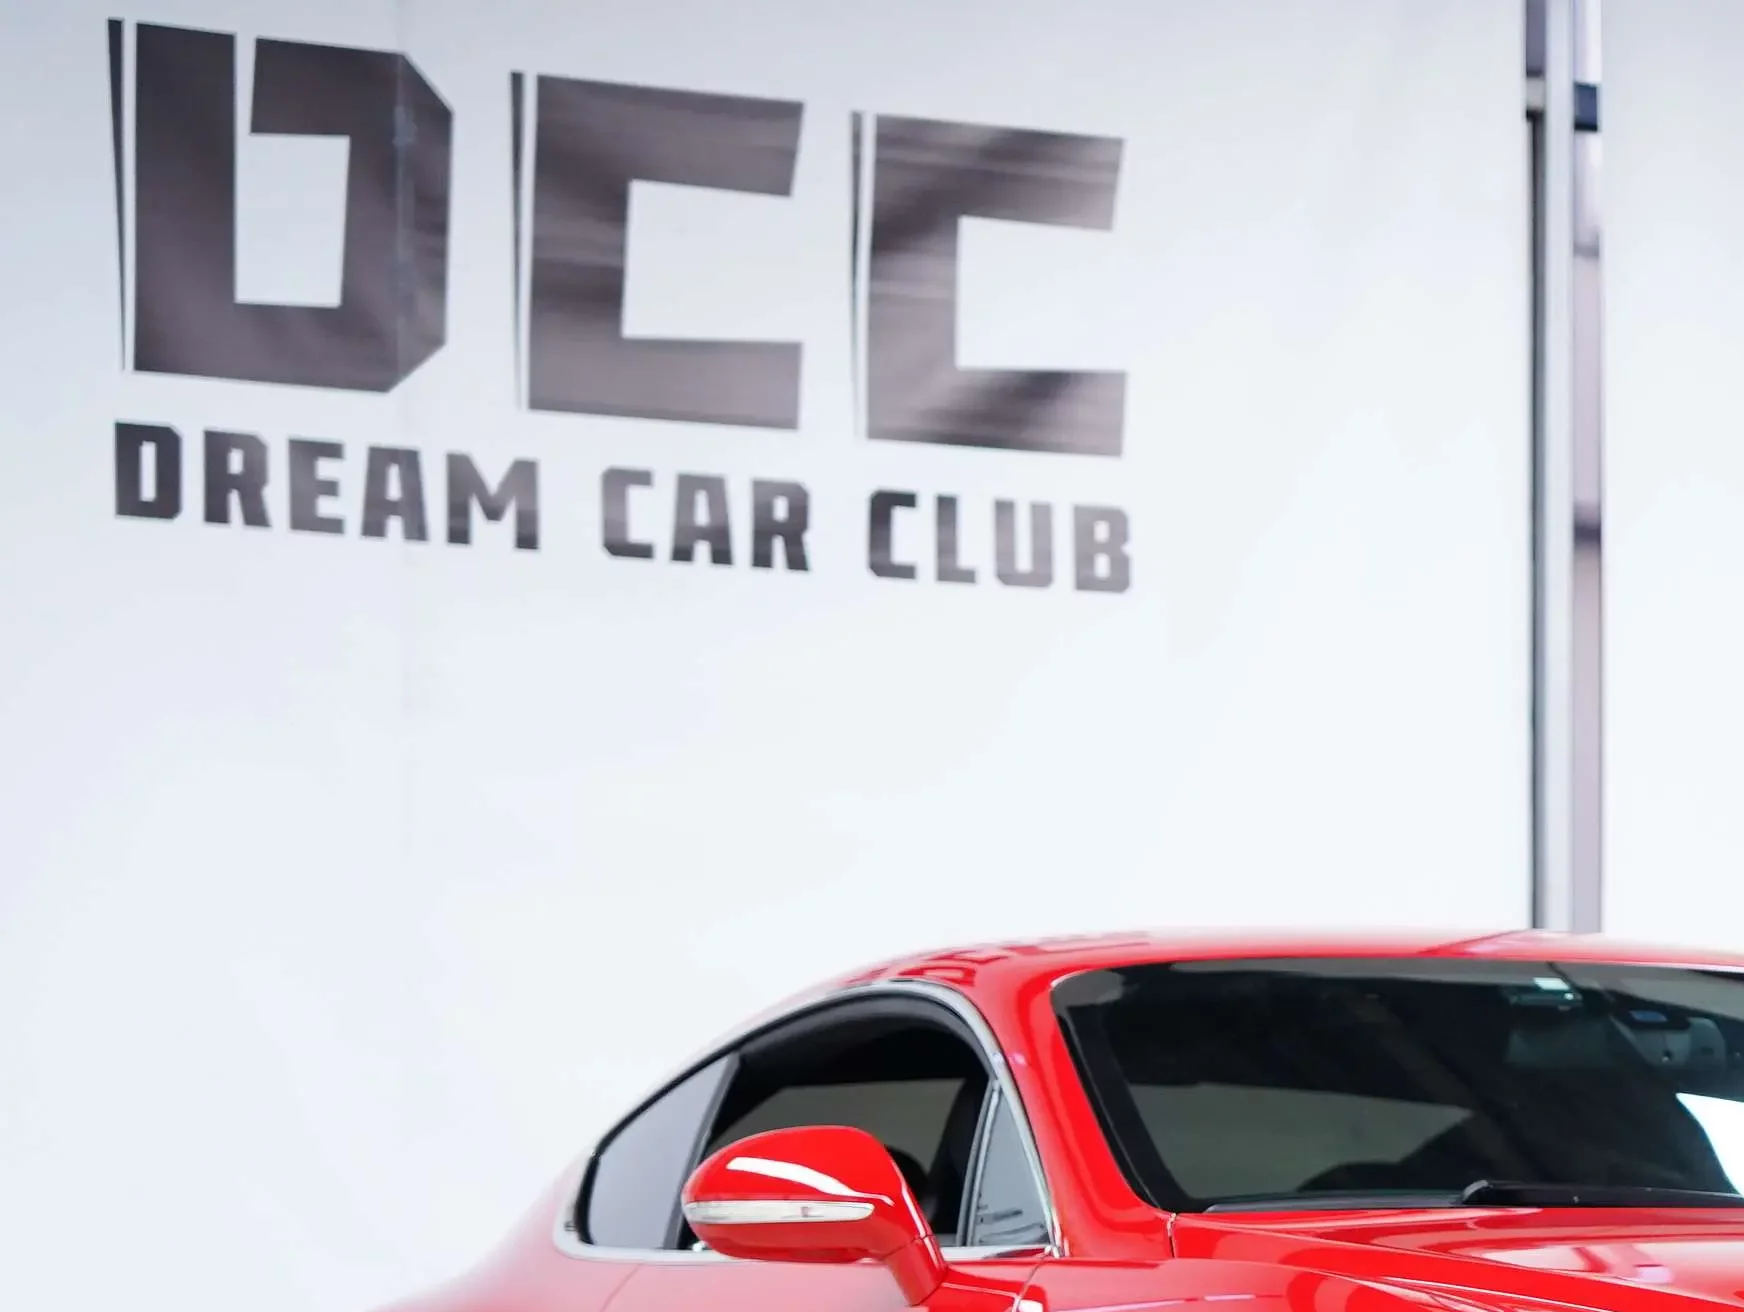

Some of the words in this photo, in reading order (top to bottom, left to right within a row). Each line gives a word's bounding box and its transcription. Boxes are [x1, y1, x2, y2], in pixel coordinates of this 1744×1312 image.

[108, 17, 1128, 458] DCC
[113, 420, 541, 552] DREAM
[599, 466, 811, 573] CAR
[867, 489, 1132, 594] CLUB
